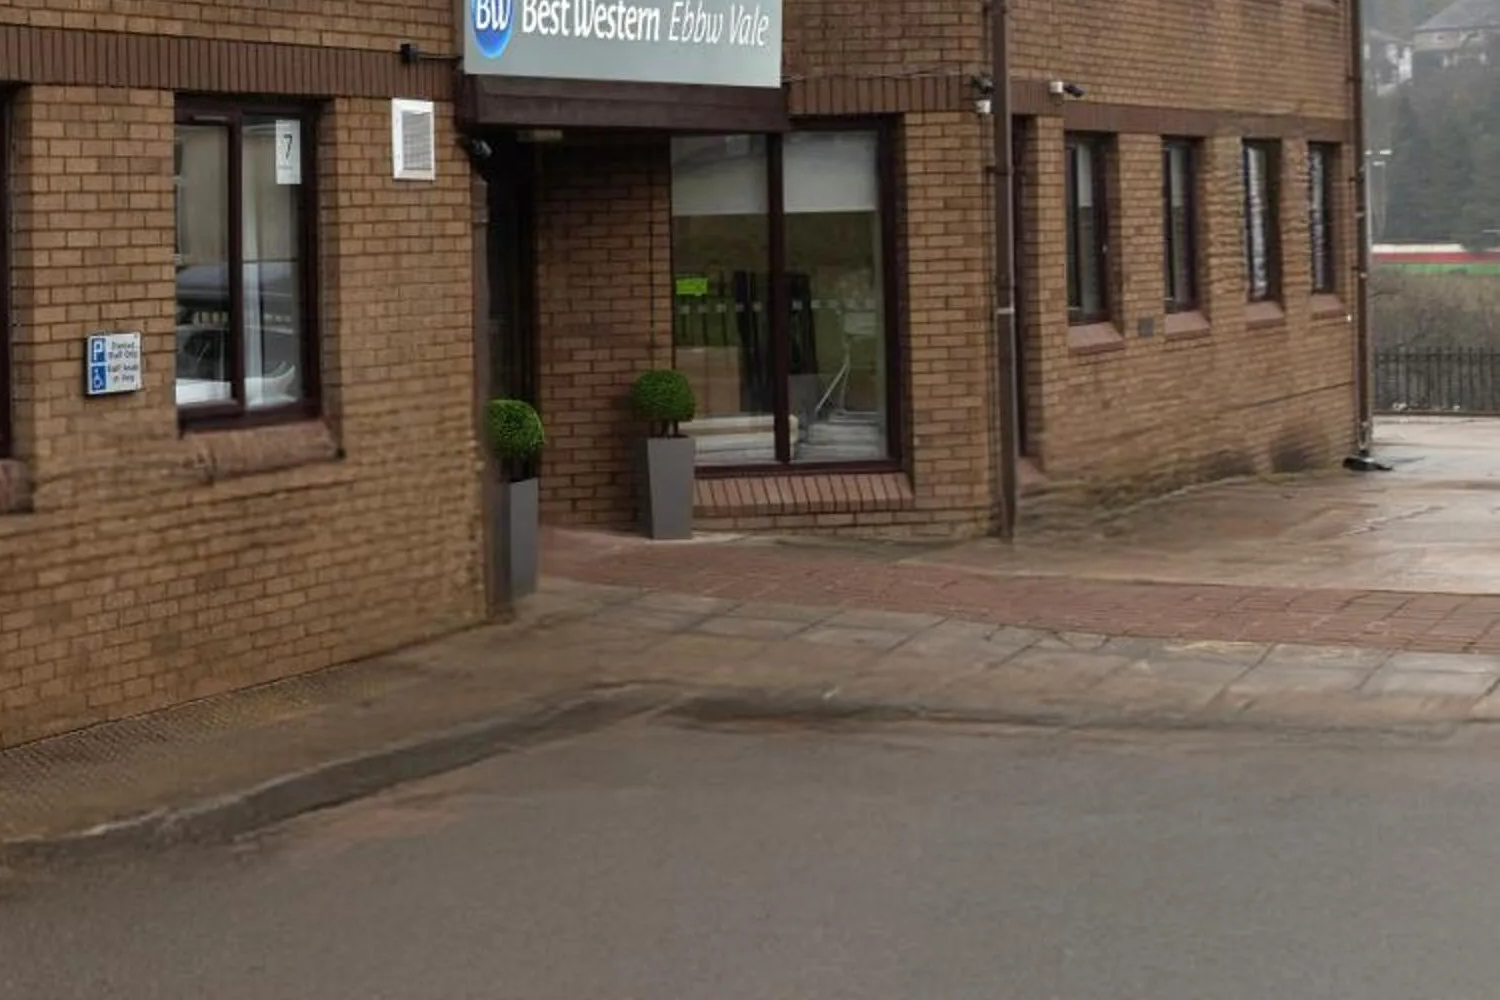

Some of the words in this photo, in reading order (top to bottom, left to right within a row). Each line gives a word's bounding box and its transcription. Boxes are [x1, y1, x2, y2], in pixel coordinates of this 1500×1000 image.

[668, 0, 723, 44] Ebbw
[729, 2, 770, 46] Vale
[93, 341, 104, 361] P
